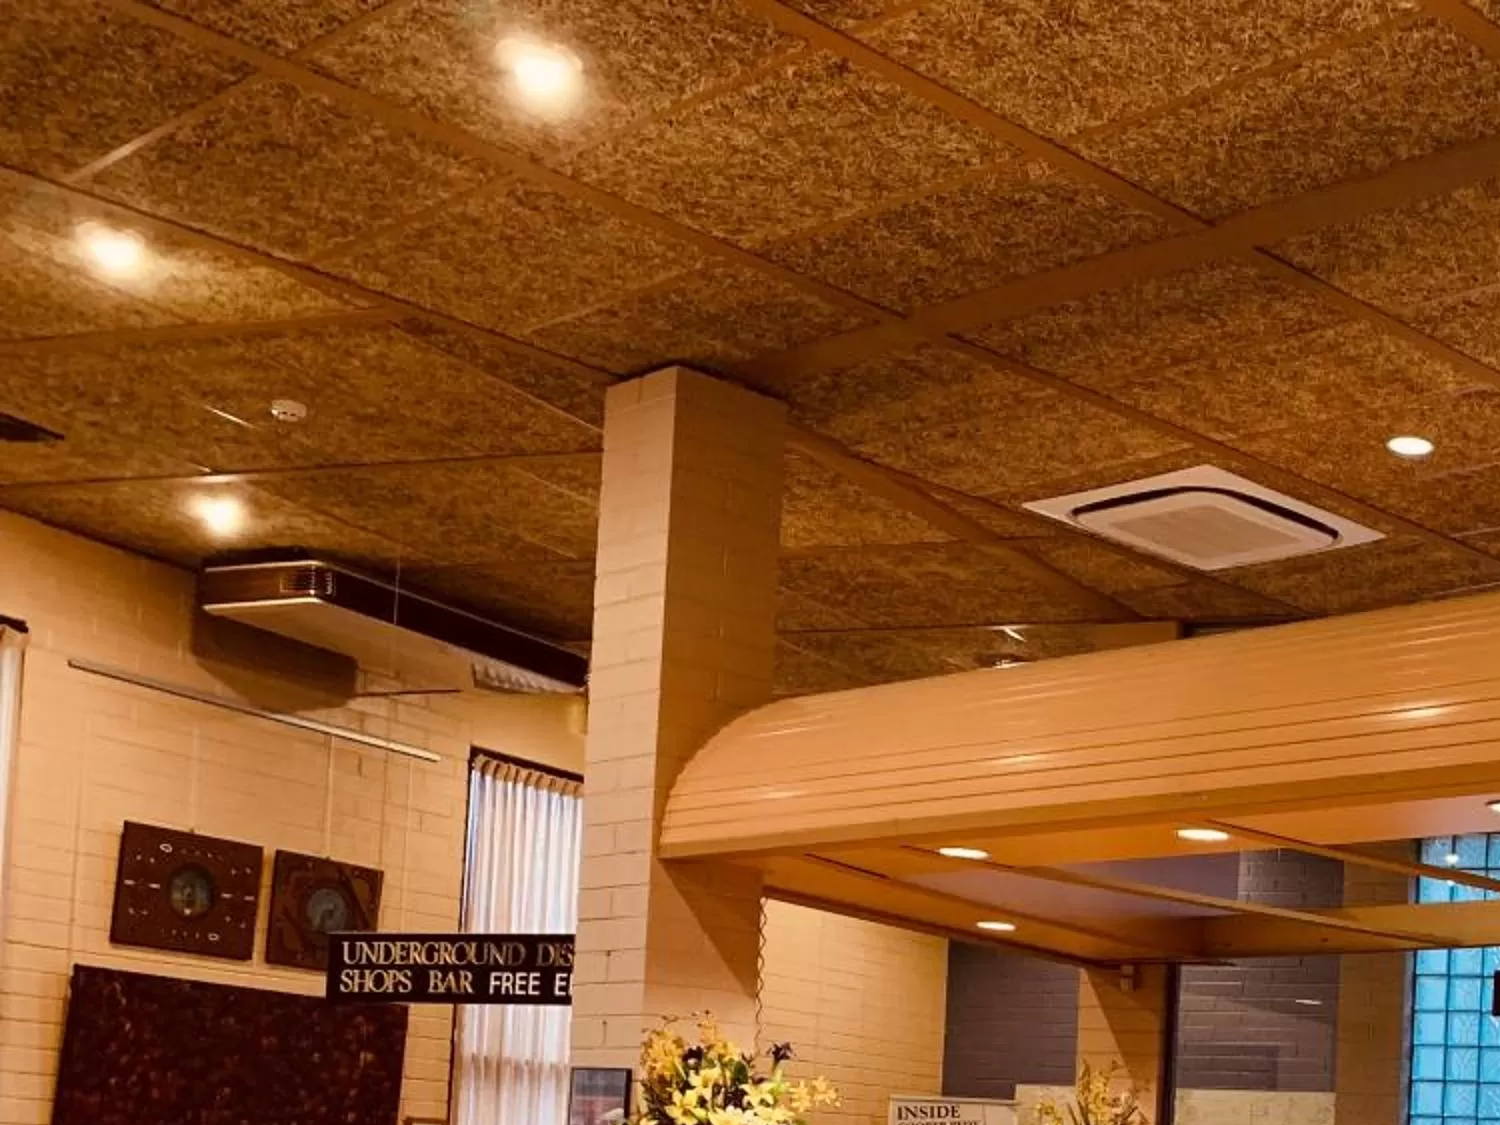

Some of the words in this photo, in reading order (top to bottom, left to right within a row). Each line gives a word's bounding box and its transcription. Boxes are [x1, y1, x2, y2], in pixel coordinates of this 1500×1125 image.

[341, 941, 526, 966] UNDERGROUND
[339, 969, 413, 994] SHOPS
[428, 970, 474, 994] BAR
[488, 972, 541, 996] FREE
[897, 1105, 961, 1120] INSIDE
